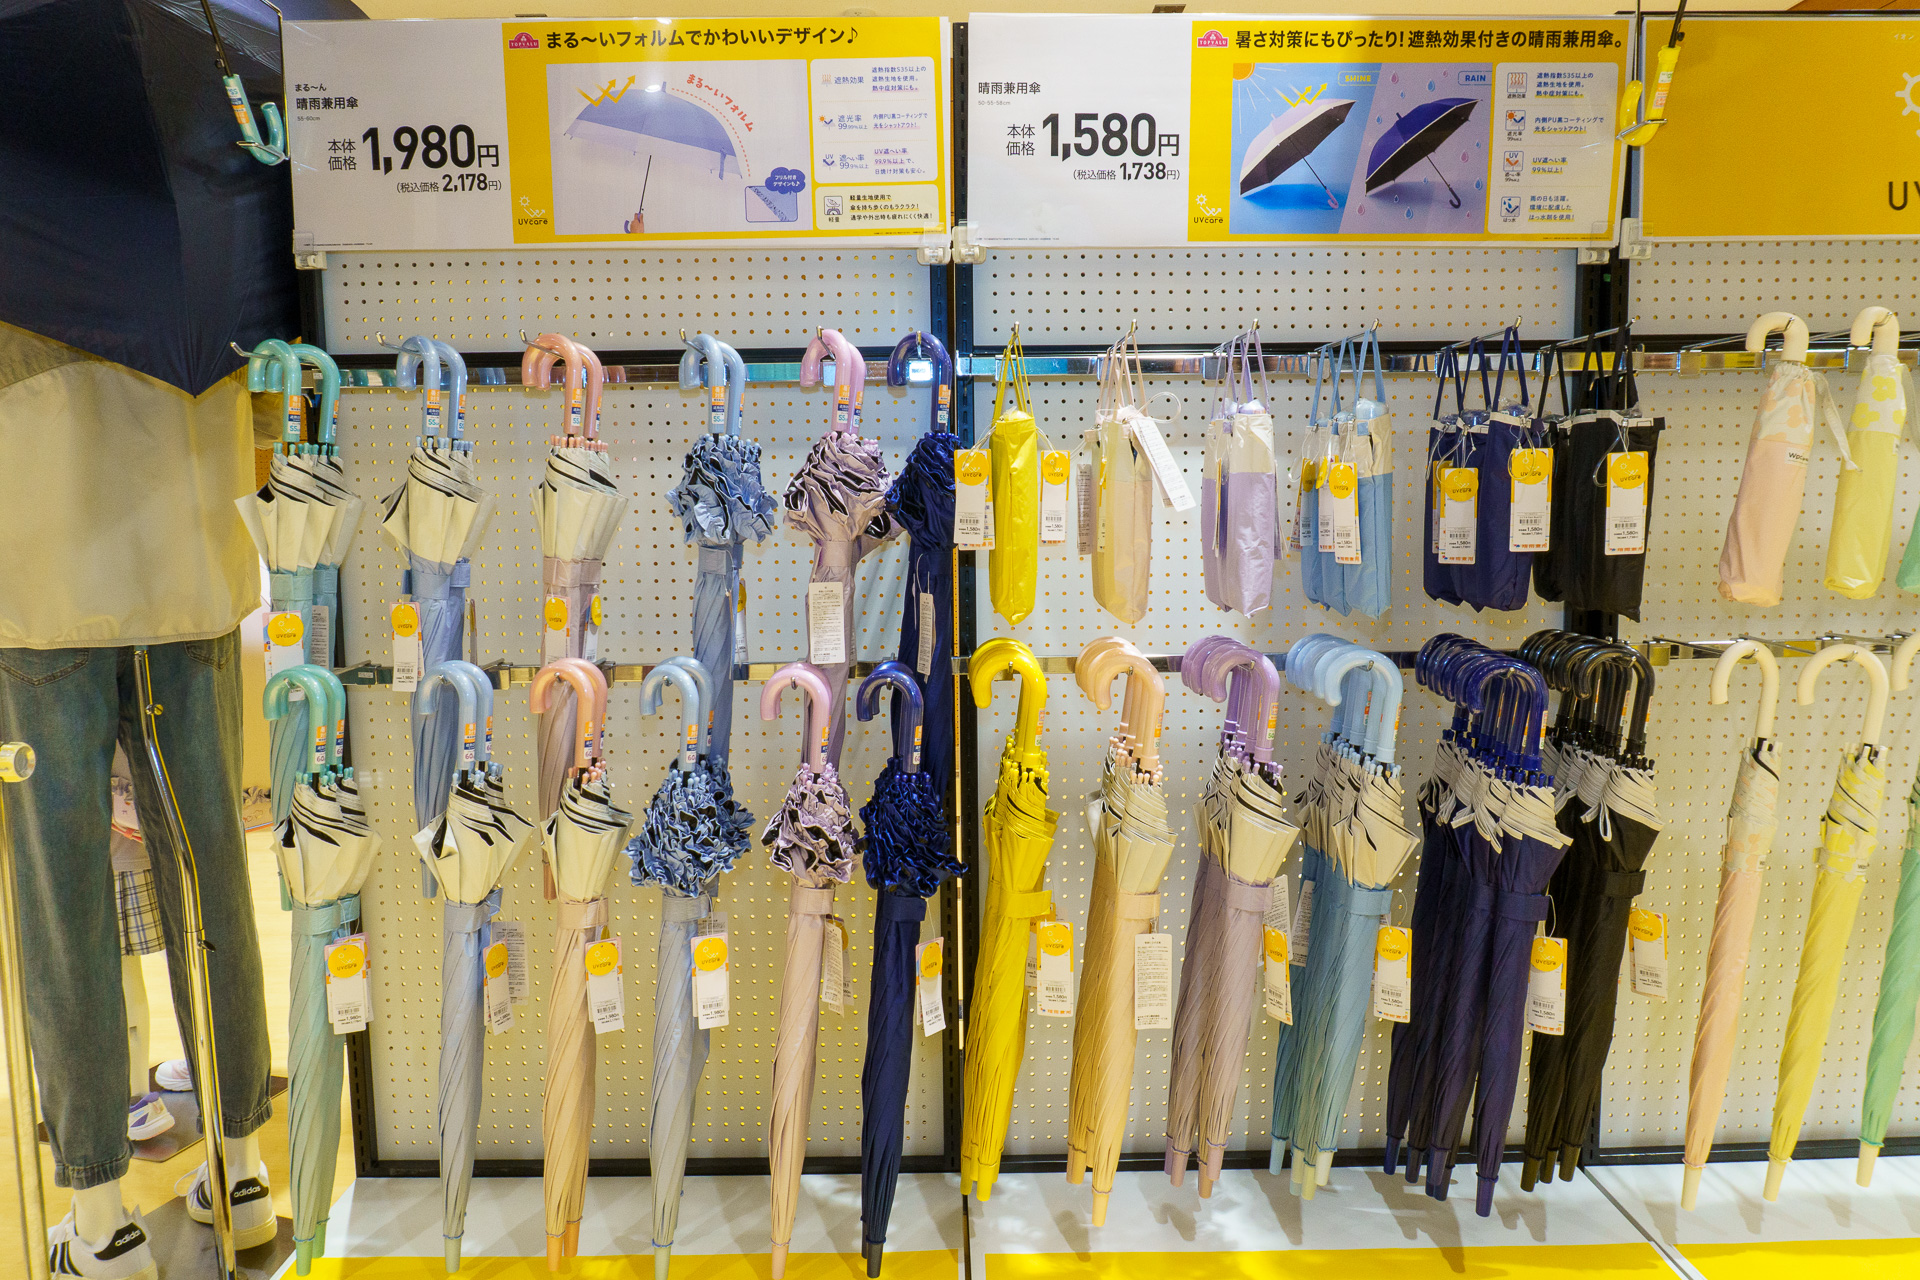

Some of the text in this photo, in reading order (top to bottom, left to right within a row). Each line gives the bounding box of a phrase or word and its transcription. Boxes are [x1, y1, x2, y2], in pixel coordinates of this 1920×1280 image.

[1235, 29, 1622, 49] 暑さ対策にもぴったり!遮熱効果付きの晴雨兼用傘。
[834, 76, 865, 85] 遮熱効果
[871, 75, 920, 83] 遮熱生地を使用。
[1464, 74, 1487, 82] RAIN
[871, 84, 919, 92] 熱中症対策にも。
[977, 82, 1041, 95] 晴雨兼用傘
[295, 96, 359, 111] 晴雨兼用傘
[837, 114, 862, 123] 遮光率
[1007, 124, 1036, 139] 本体
[1042, 112, 1180, 162] 1,580円
[327, 138, 356, 154] 本体
[362, 124, 500, 176] 1,980円
[1006, 141, 1036, 157] 価格
[327, 156, 357, 171] 価格
[874, 167, 926, 176] 日焼け対策も安心。
[850, 193, 892, 201] 軽量生地使用で
[517, 217, 549, 226] UVcare
[1193, 216, 1224, 224] UVcare
[234, 1184, 261, 1199] adidas
[114, 1228, 142, 1247] adidas
